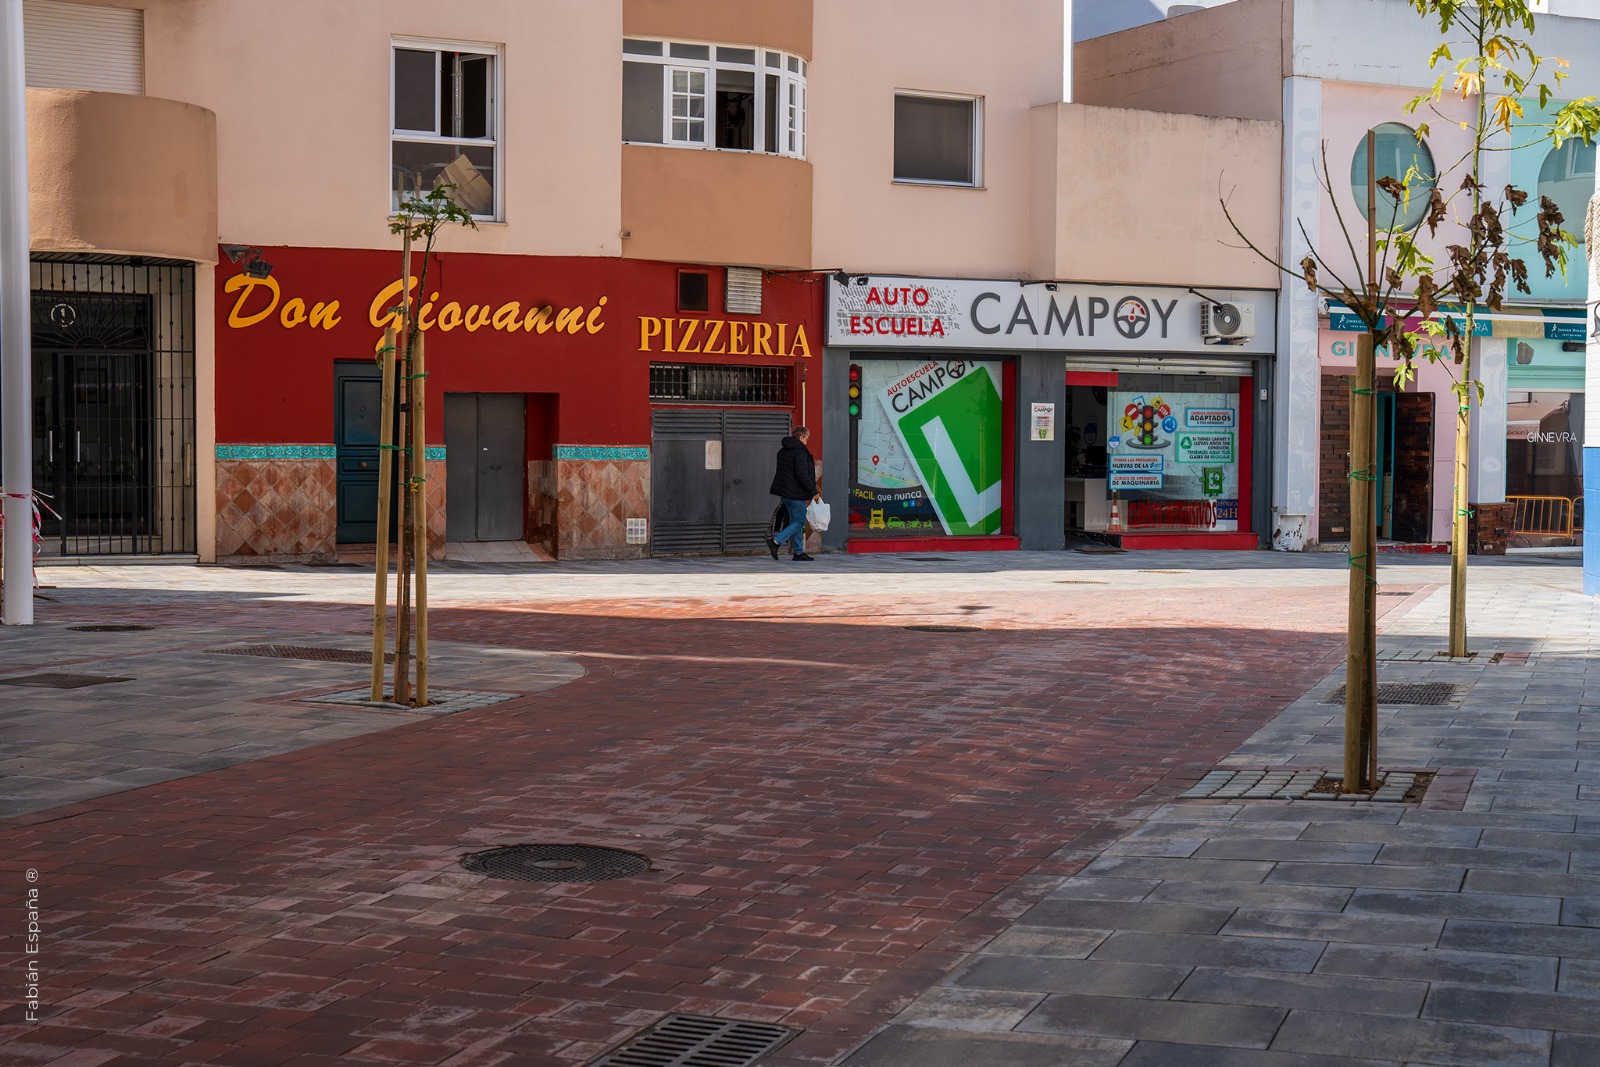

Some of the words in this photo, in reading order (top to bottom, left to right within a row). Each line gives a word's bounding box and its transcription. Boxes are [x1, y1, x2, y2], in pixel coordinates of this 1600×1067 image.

[866, 286, 930, 307] AUTO
[225, 272, 341, 330] Don
[369, 276, 608, 353] Giovanni
[970, 291, 1179, 340] CAMPOY
[637, 316, 813, 358] PIZZERIA
[850, 315, 946, 336] ESCUELA
[887, 360, 939, 397] AUTOESCUELA
[1527, 432, 1578, 443] GINNEVRA
[877, 494, 892, 502] que
[894, 490, 922, 500] nunca
[1165, 501, 1217, 528] INTENSIVOS
[1217, 508, 1238, 518] 24H
